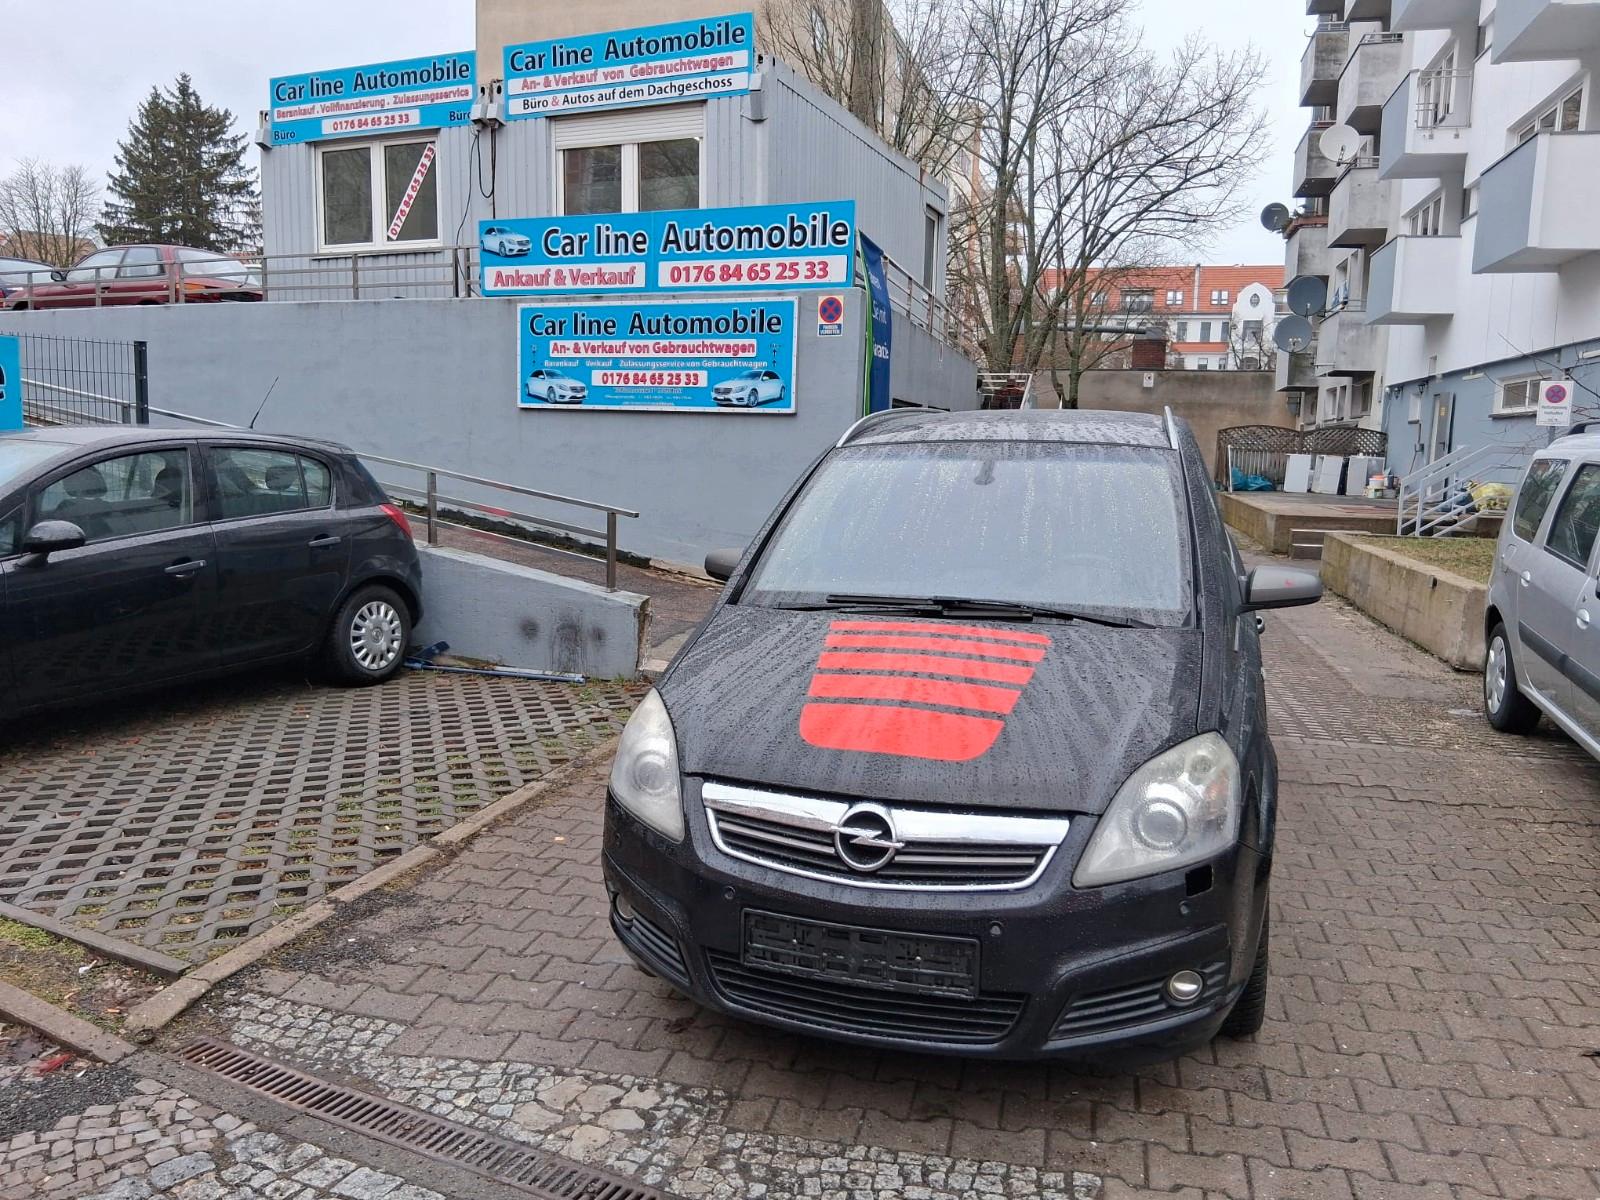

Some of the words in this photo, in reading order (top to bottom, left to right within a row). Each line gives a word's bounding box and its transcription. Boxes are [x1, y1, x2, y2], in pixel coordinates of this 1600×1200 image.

[510, 50, 546, 71] Car
[552, 44, 593, 67] line
[604, 20, 745, 60] Automobile
[275, 82, 305, 101] Car
[310, 77, 344, 97] line
[353, 59, 470, 92] Automobile
[522, 78, 540, 90] An-
[543, 76, 552, 88] &
[554, 68, 598, 87] Verkauf
[602, 69, 624, 81] von
[629, 55, 733, 77] Gebrauchtwagen
[320, 98, 385, 113] Vollfinanzierung
[393, 88, 469, 105] Zulassungsservice
[523, 98, 548, 110] Büro
[551, 95, 560, 107] &
[562, 93, 594, 106] Autos
[598, 89, 616, 101] auf
[619, 87, 644, 99] dem
[647, 77, 732, 96] Dachgeschoss
[333, 120, 355, 131] 0176
[357, 118, 368, 129] 84
[370, 117, 381, 127] 65
[384, 115, 396, 125] 25
[398, 113, 409, 123] 33
[274, 130, 296, 140] Büro
[390, 209, 406, 236] 0176
[403, 193, 414, 208] 84
[411, 177, 420, 193] 65
[417, 162, 427, 177] 25
[424, 146, 434, 162] 33
[543, 227, 589, 258] Car
[595, 224, 648, 256] line
[660, 212, 849, 253] Automobile
[494, 267, 552, 288] Ankauf
[554, 268, 567, 287] &
[569, 266, 636, 286] Verkauf
[670, 265, 715, 283] 0176
[719, 264, 743, 282] 84
[746, 263, 770, 281] 65
[774, 261, 799, 280] 25
[803, 260, 829, 279] 33
[529, 313, 567, 336] Car
[573, 311, 617, 336] line
[628, 308, 782, 336] Automobile
[552, 342, 570, 354] An-
[573, 342, 581, 354] &
[583, 341, 627, 354] Verkauf
[629, 343, 650, 354] von
[652, 341, 755, 356] Gebrauchtwagen
[619, 359, 685, 369] Zulassungsservice
[702, 359, 768, 369] Gebrauchtwagen
[601, 373, 630, 385] 0176
[633, 373, 647, 385] 84
[650, 373, 664, 385] 65
[667, 372, 682, 385] 25
[684, 372, 699, 385] 33
